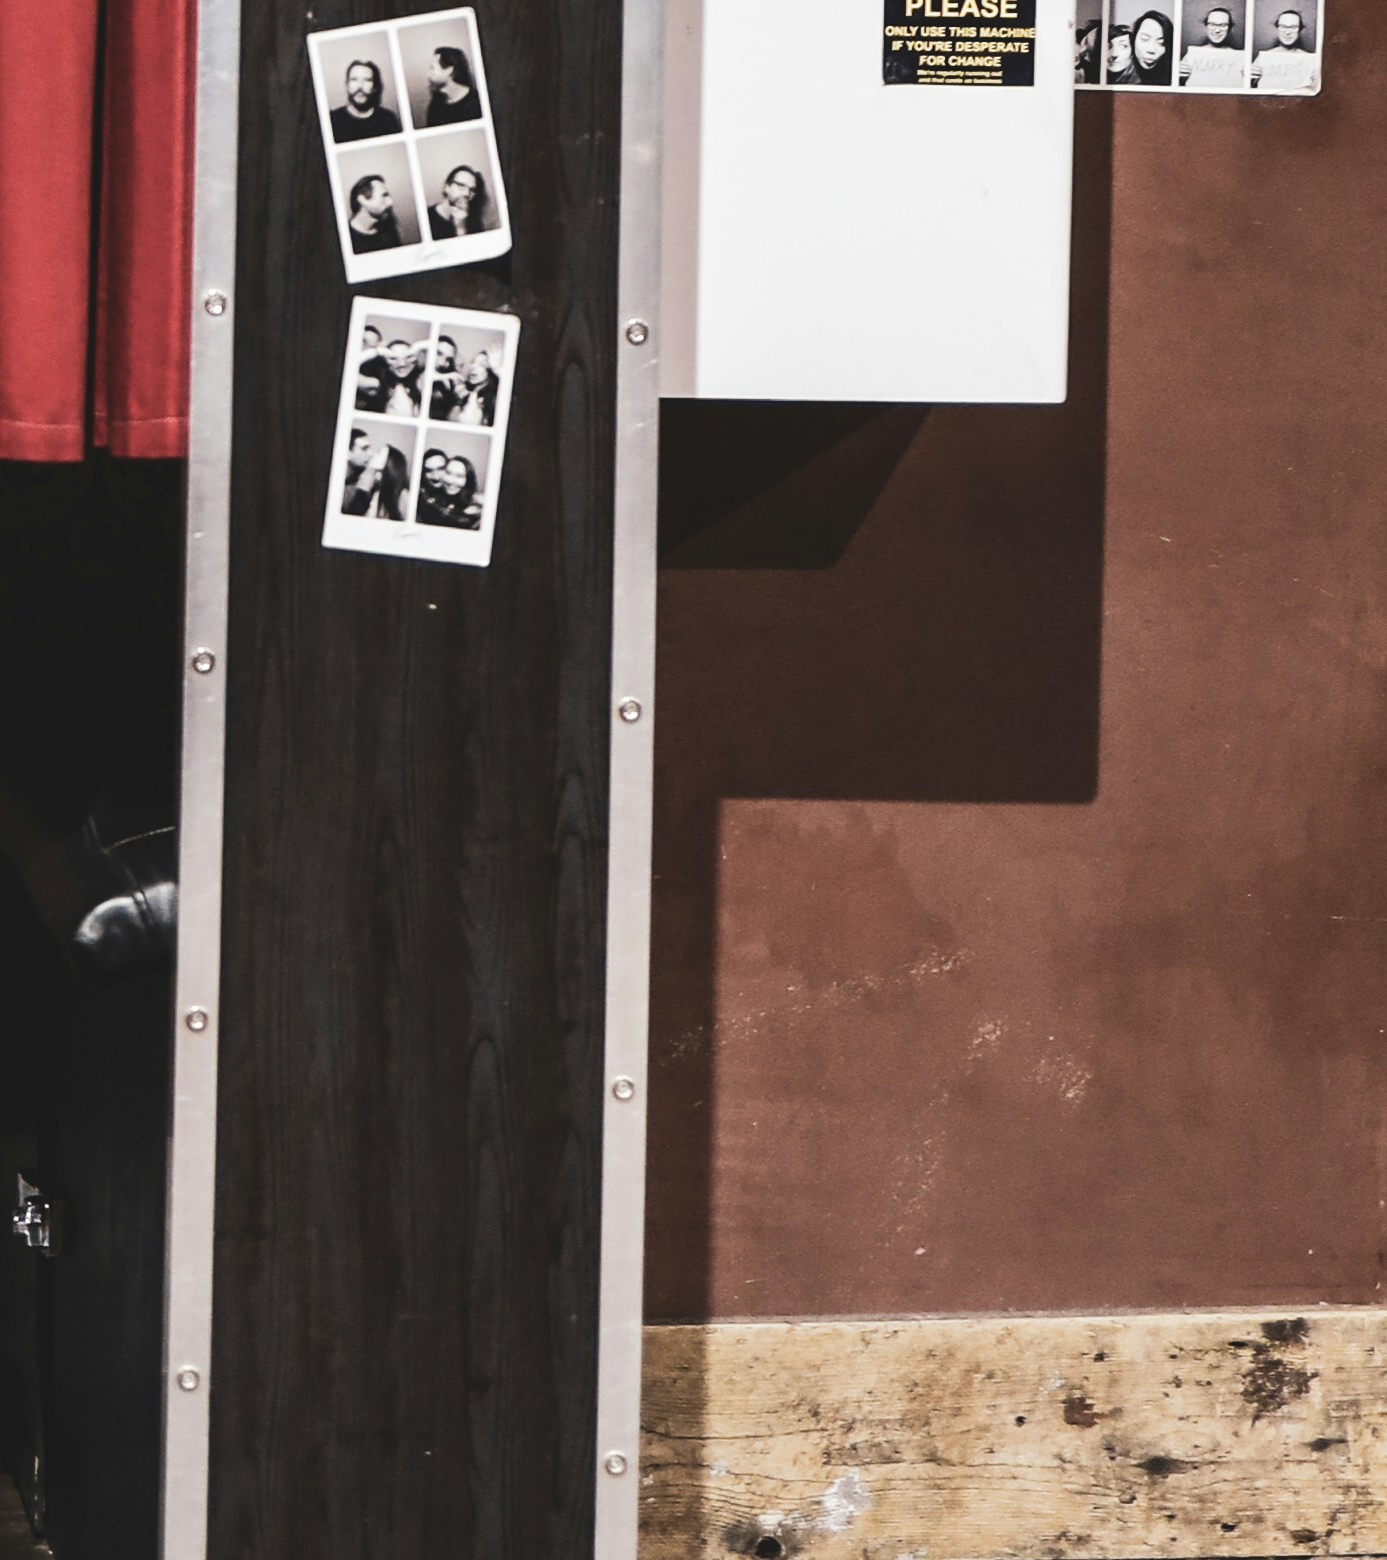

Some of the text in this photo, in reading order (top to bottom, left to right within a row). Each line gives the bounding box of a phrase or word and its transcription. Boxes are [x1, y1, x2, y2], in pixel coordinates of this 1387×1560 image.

[884, 25, 1036, 39] ONLY USE THIS MACHINE
[891, 40, 1030, 54] IF YOU'RE DESPERATE
[918, 55, 1002, 68] FOR CHANGE
